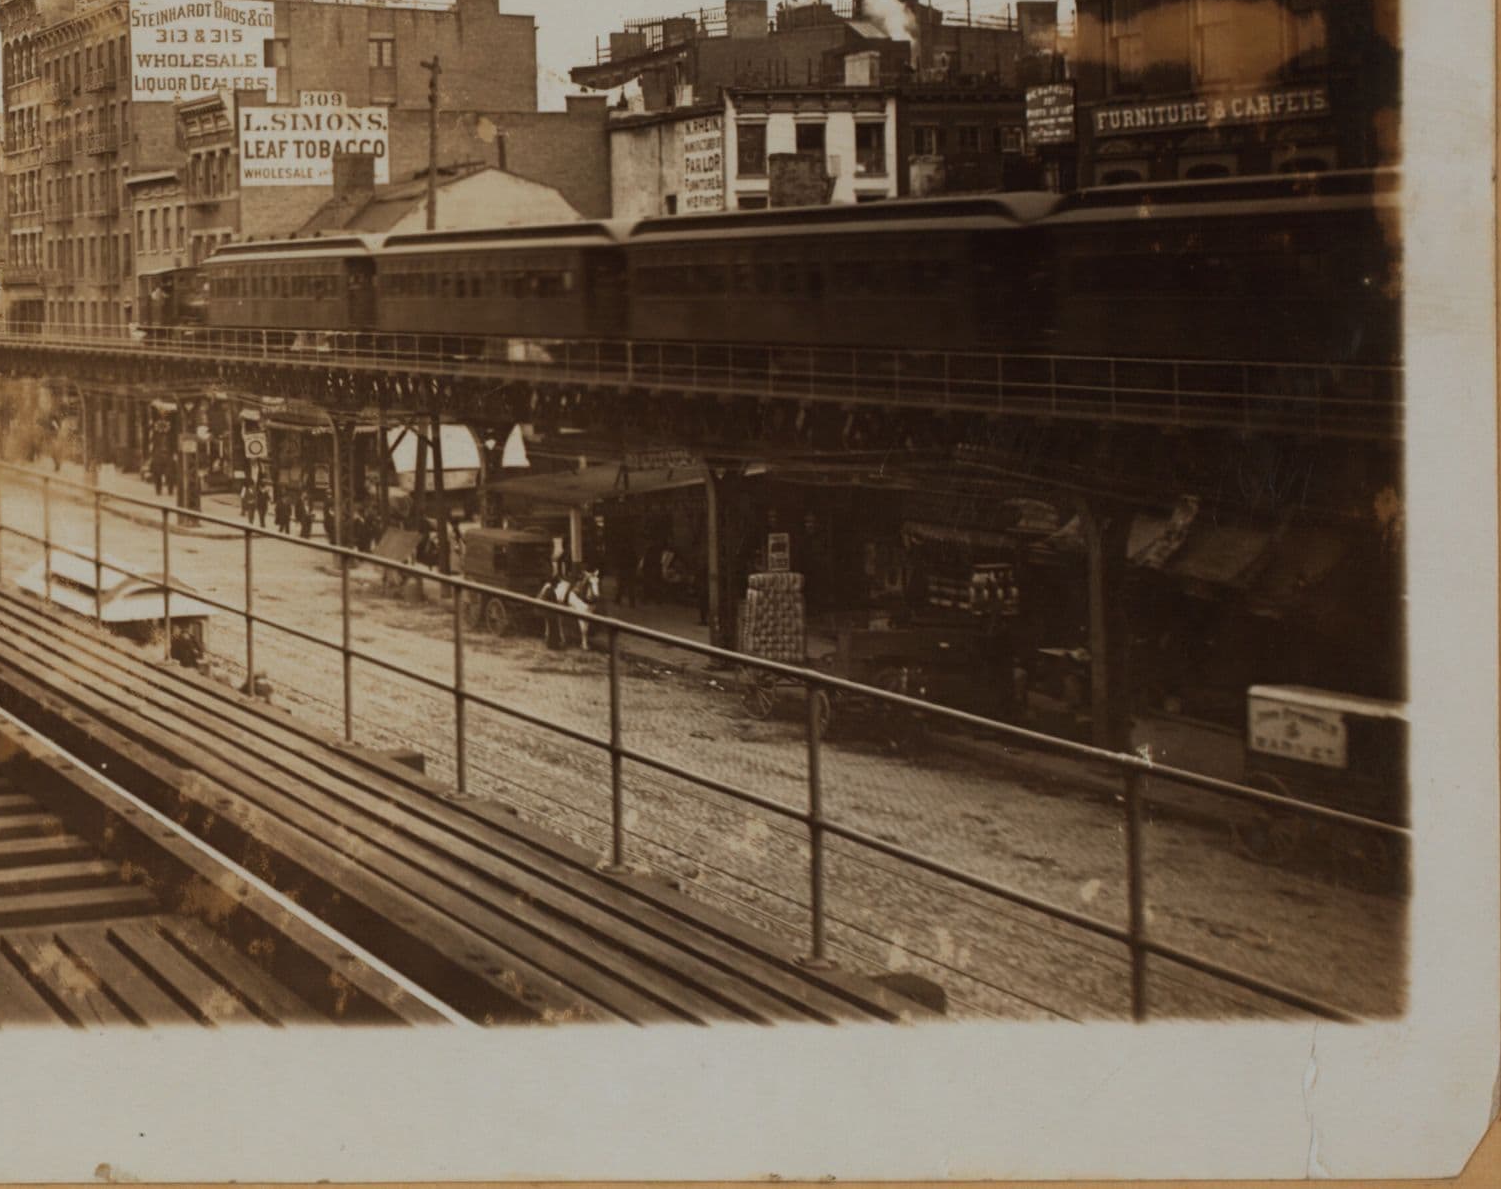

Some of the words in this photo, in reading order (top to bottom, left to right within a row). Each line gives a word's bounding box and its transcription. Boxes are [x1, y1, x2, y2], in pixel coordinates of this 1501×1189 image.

[155, 29, 188, 43] 313
[194, 29, 206, 43] &
[210, 29, 243, 43] 315
[135, 53, 258, 68] WHOLESALE
[134, 75, 187, 92] LIQUOR
[303, 93, 343, 107] 309
[1096, 102, 1208, 131] FURNITURE
[1210, 99, 1226, 121] &
[1230, 89, 1327, 118] CARPETS
[244, 140, 290, 159] LEAF
[292, 139, 386, 159] TOBACCO
[685, 153, 721, 173] PARLOR
[244, 167, 313, 179] WHOLESALE
